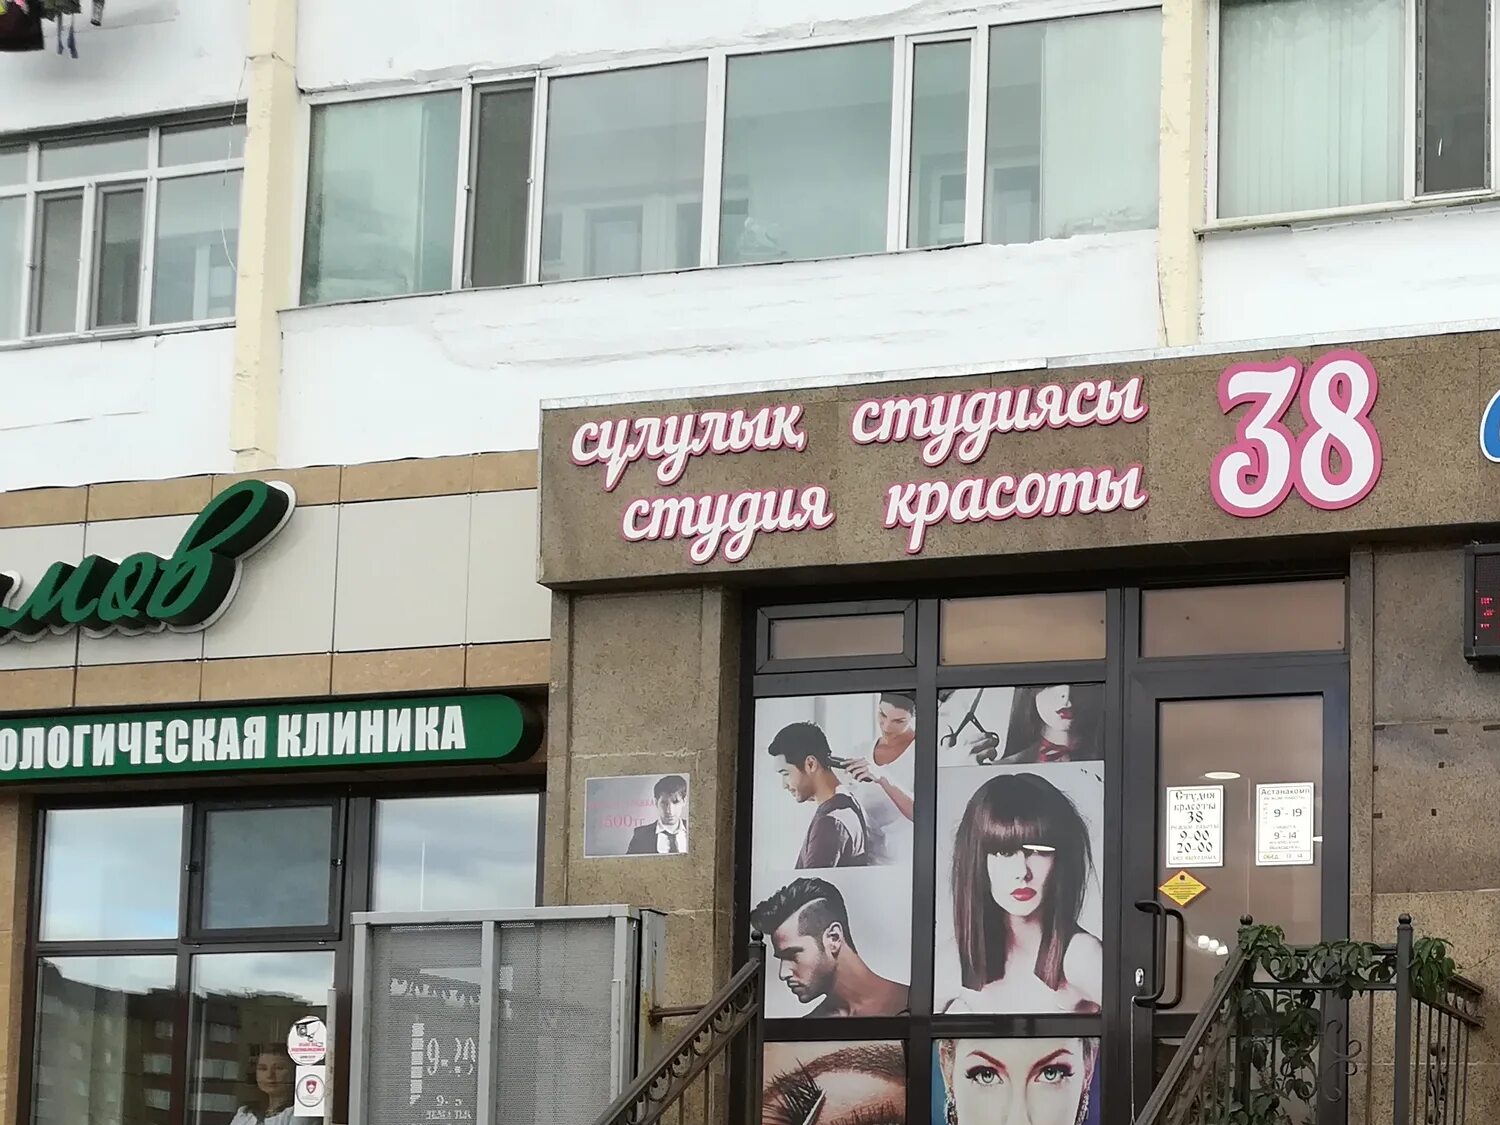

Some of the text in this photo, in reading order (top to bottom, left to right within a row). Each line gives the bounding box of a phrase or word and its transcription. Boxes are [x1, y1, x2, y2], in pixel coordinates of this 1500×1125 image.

[850, 376, 1148, 466] студиясы
[1209, 348, 1383, 519] 38
[0, 480, 290, 636] мов
[621, 464, 1148, 566] студия красоты
[0, 705, 467, 772] ОЛОГИЧЕСКАЯ КЛИНИКА
